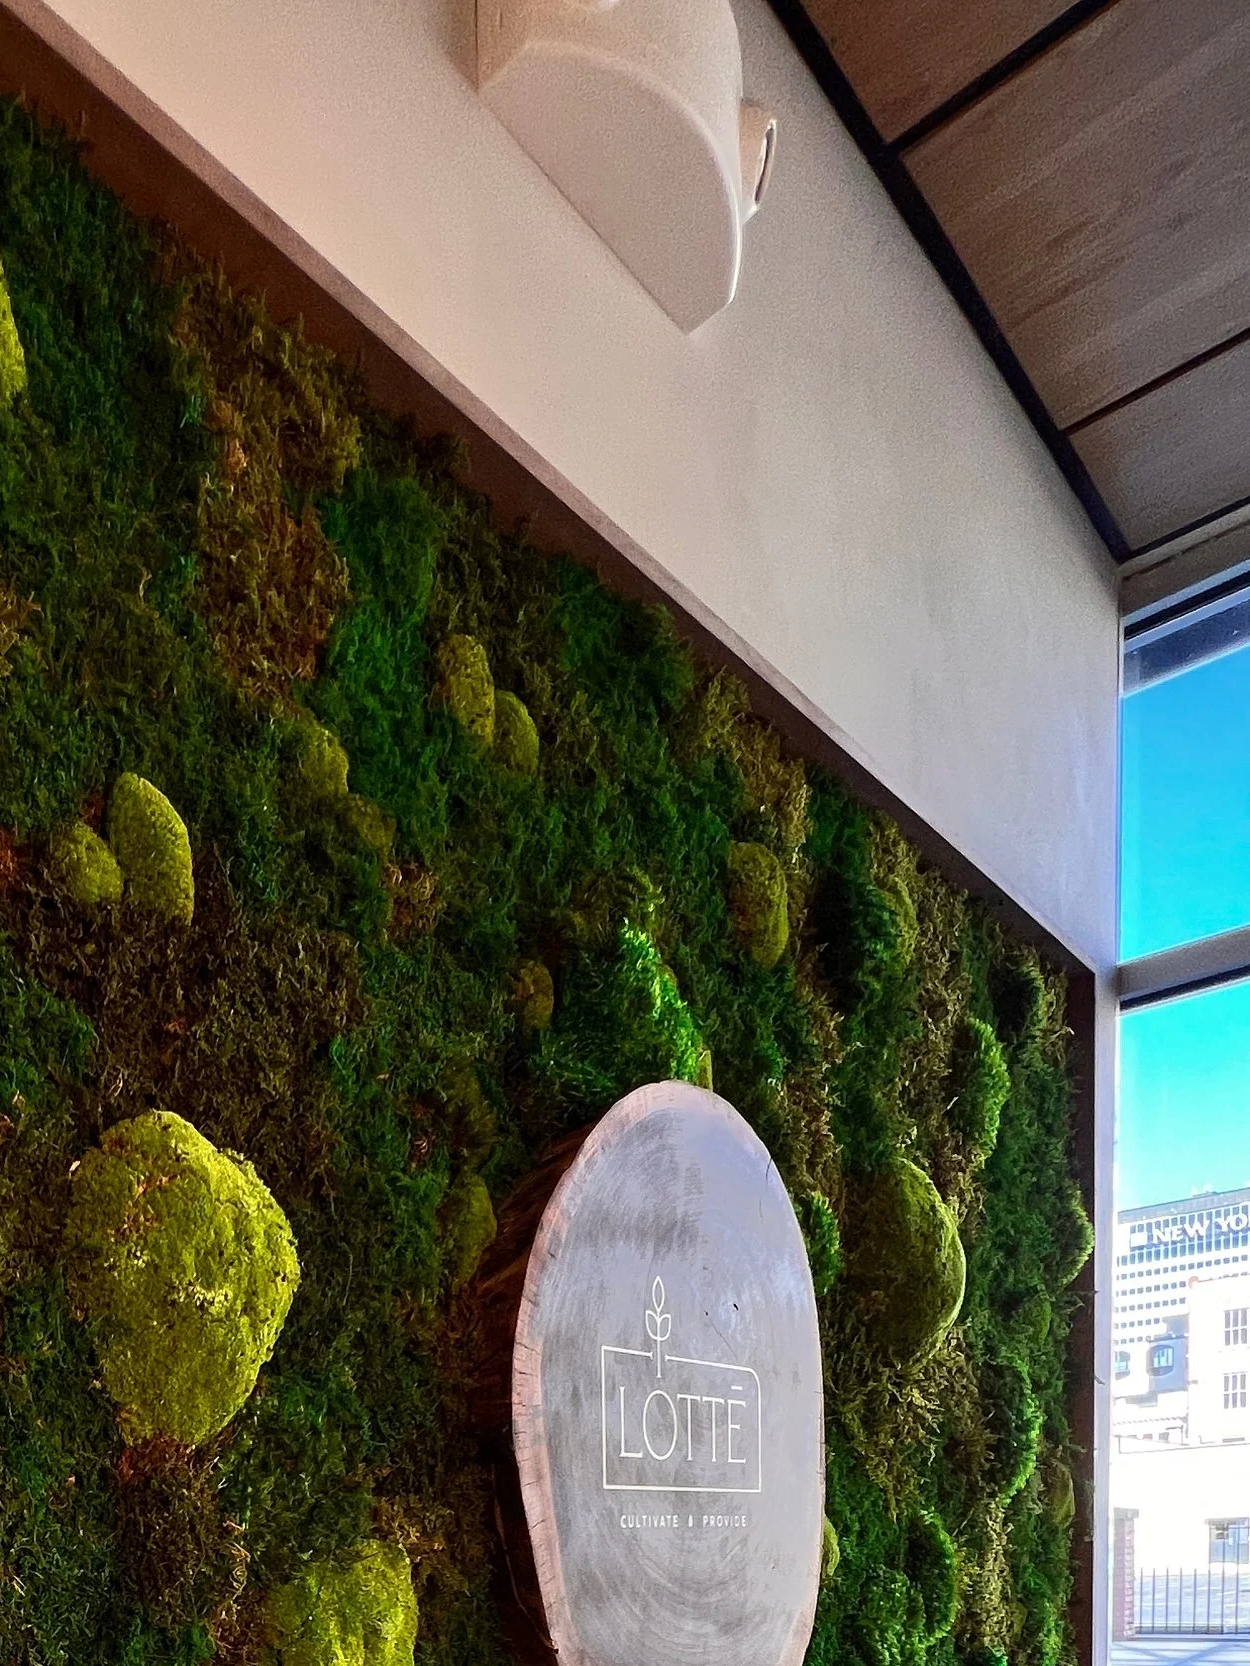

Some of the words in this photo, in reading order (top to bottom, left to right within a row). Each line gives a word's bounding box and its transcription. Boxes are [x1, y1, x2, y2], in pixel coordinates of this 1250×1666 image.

[1153, 1220, 1210, 1244] NEW
[1214, 1213, 1250, 1232] YO
[620, 1514, 679, 1529] CULTIVATE
[702, 1514, 747, 1528] PROVIDE
